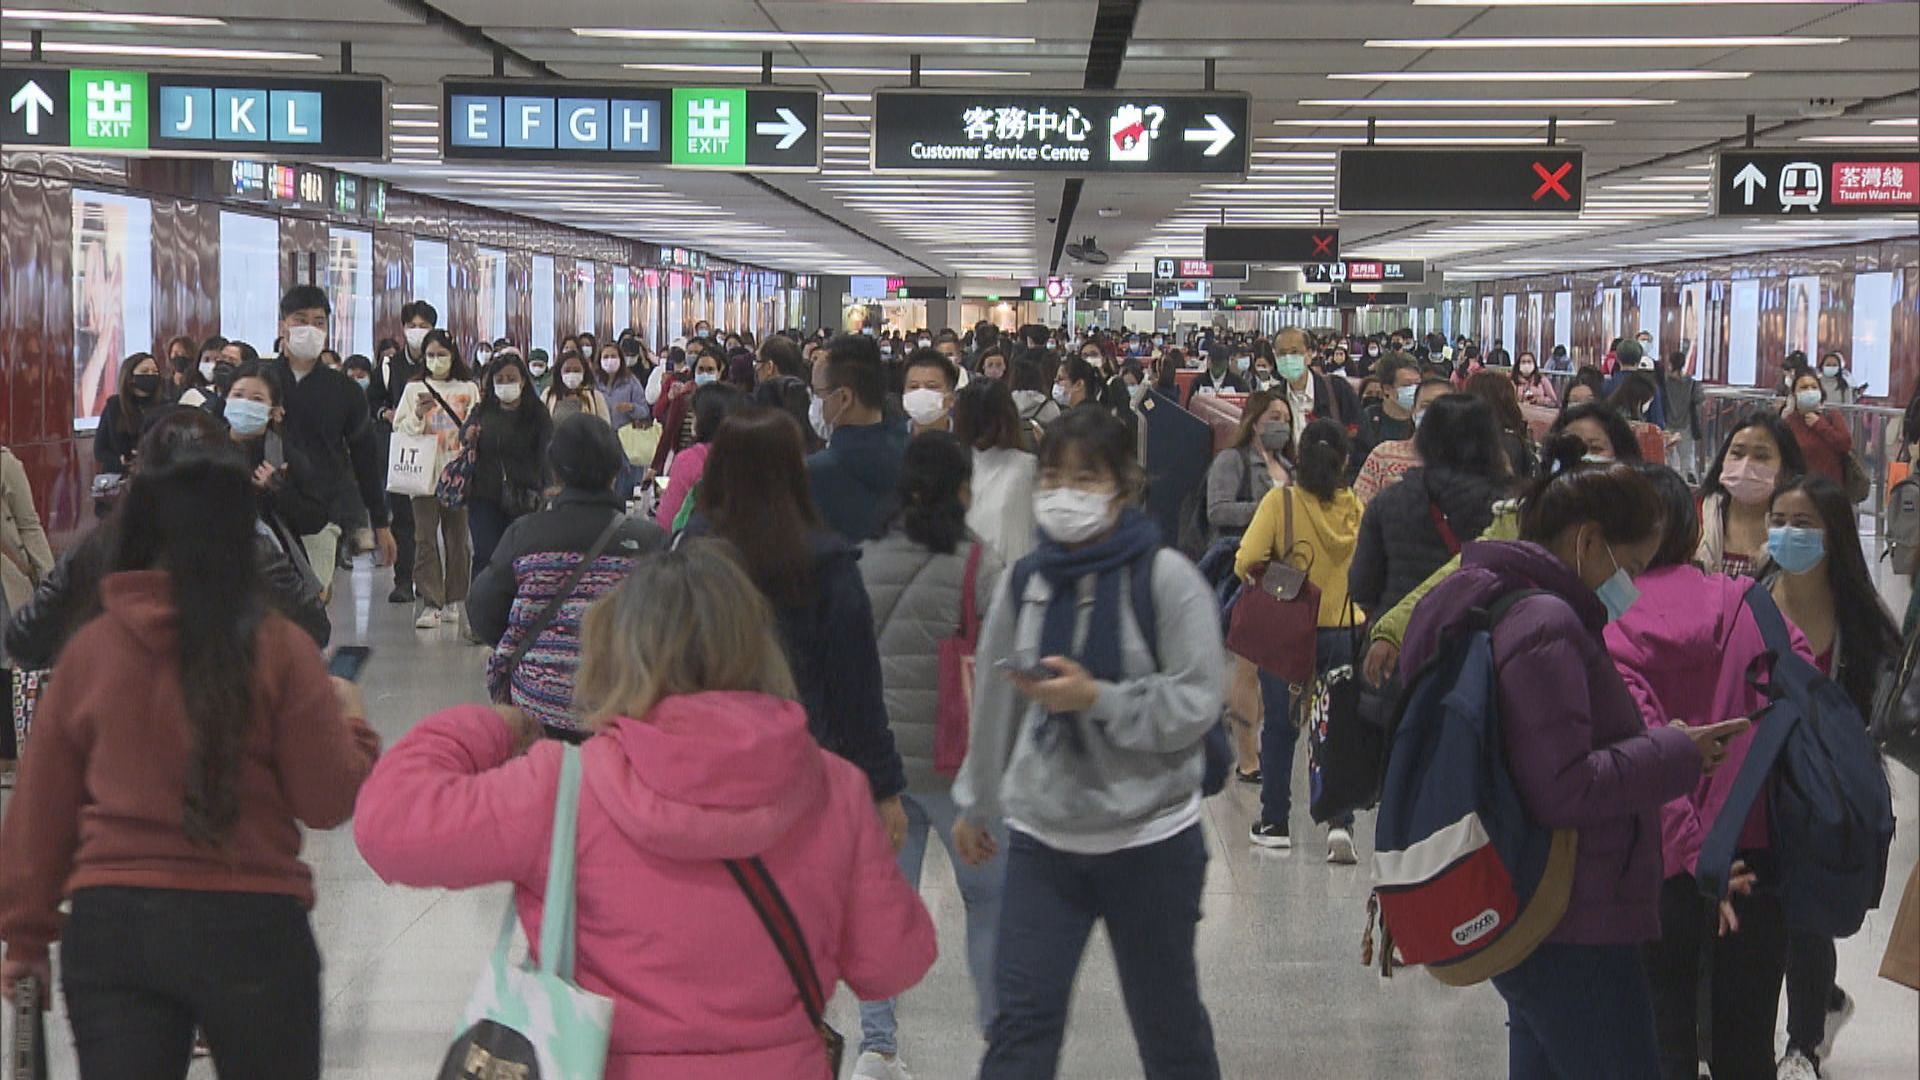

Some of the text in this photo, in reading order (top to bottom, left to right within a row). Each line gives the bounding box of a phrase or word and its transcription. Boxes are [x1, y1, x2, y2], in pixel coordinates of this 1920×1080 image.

[176, 96, 308, 135] J K L
[467, 104, 648, 143] E F G H
[963, 106, 1092, 142] 客務中心
[87, 122, 132, 138] EXIT
[688, 138, 730, 154] EXIT
[910, 142, 1090, 161] Customer Service Centre
[1839, 190, 1912, 200] Tsuen Wan Line
